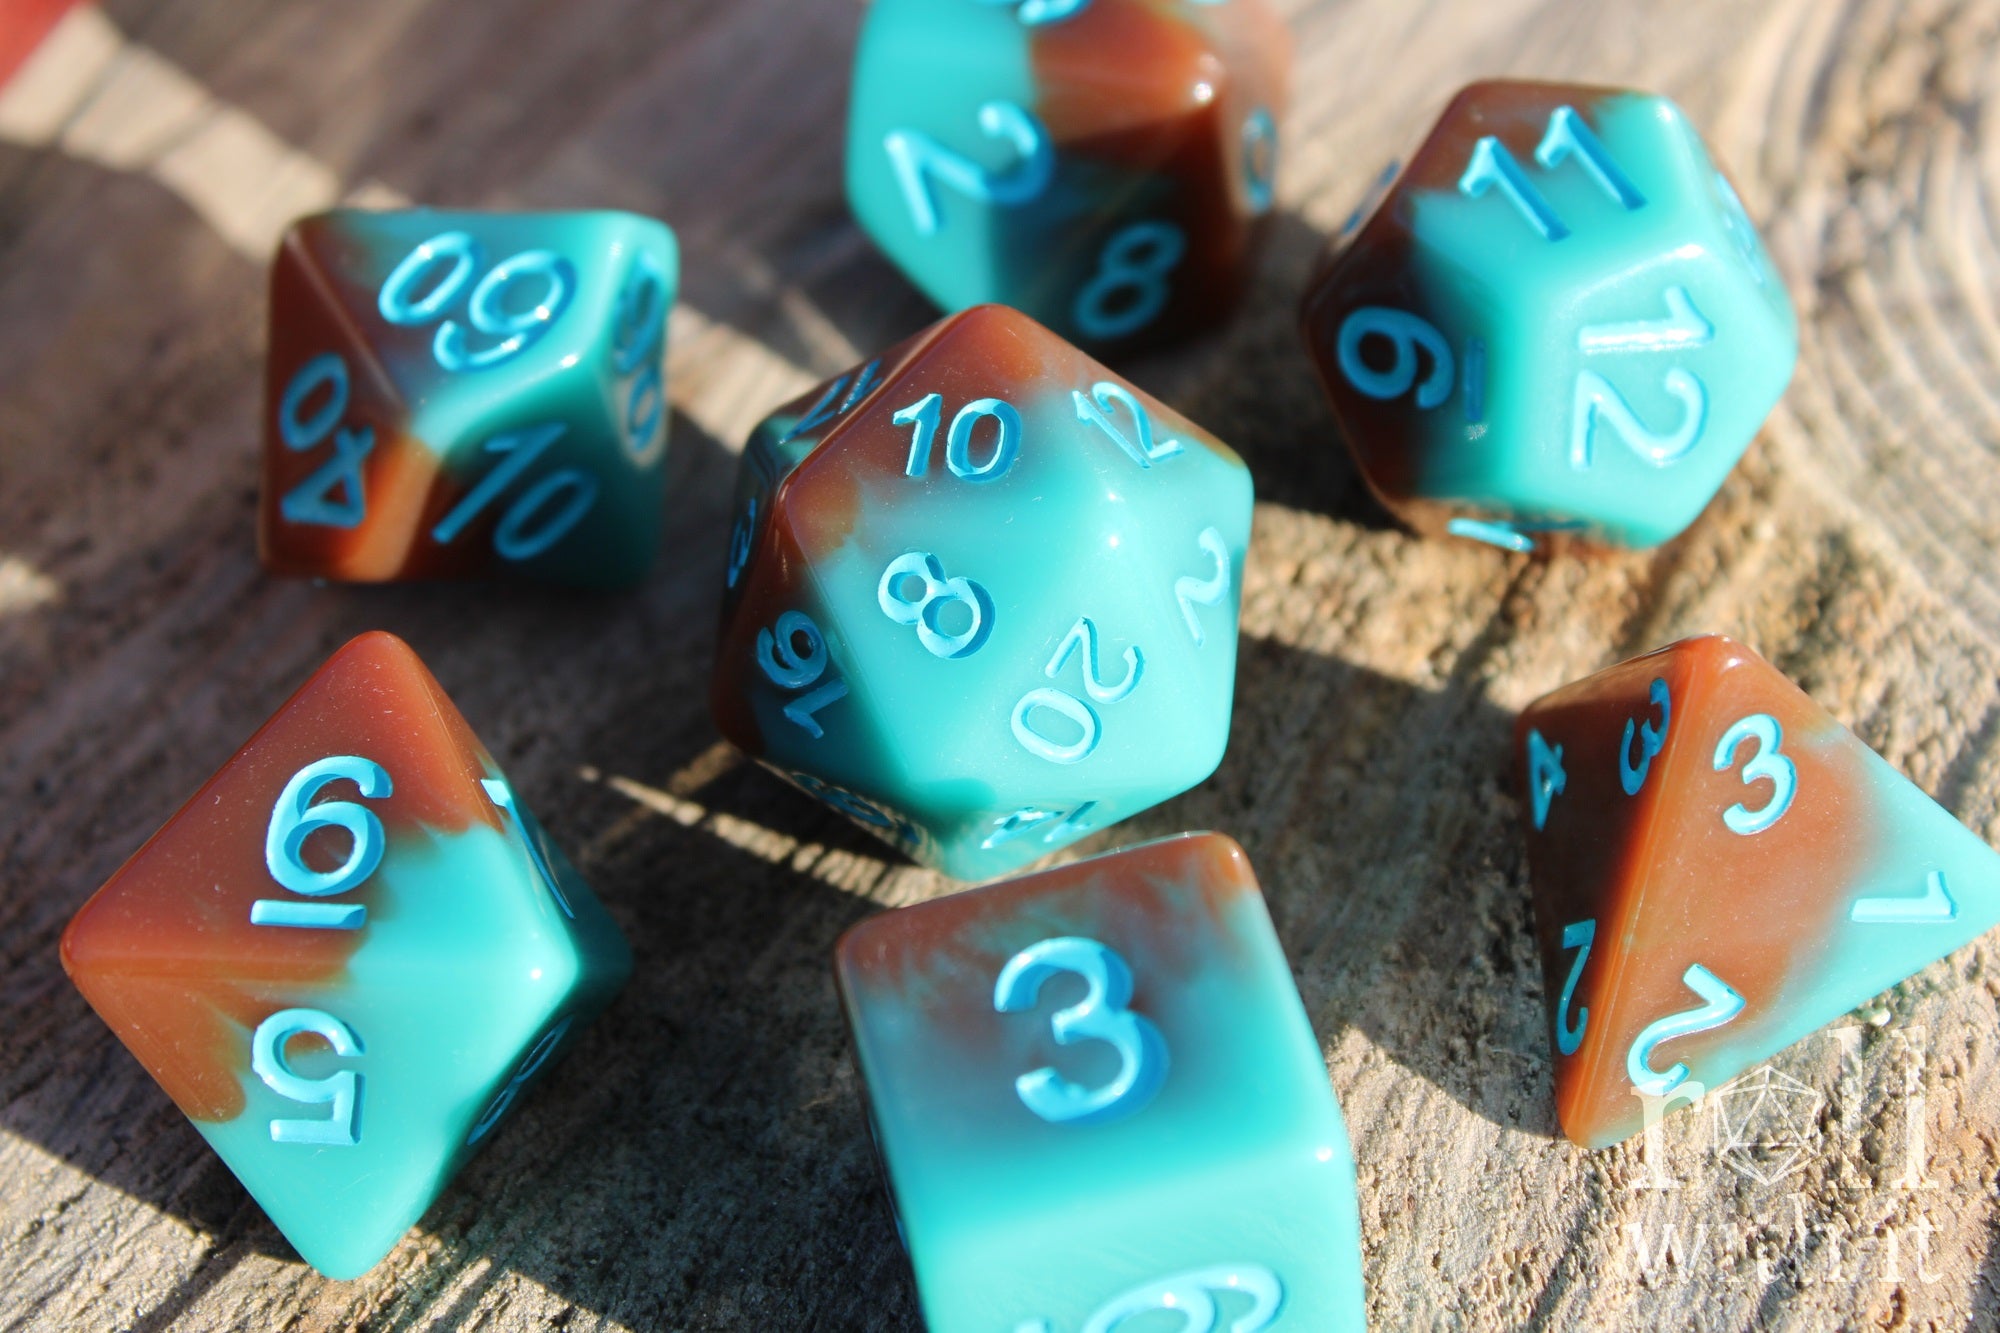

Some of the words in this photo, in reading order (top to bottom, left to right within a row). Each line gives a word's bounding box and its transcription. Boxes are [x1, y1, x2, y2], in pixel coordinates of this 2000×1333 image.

[1459, 105, 1648, 241] 11
[1073, 220, 1186, 339] 8
[279, 354, 376, 529] 40
[892, 393, 1022, 483] 10
[1072, 381, 1185, 468] 12
[1570, 285, 1715, 472] 12
[431, 423, 595, 560] 10
[878, 551, 996, 660] 8
[1174, 526, 1231, 647] 2
[756, 610, 849, 739] 16
[1011, 617, 1145, 764] 20
[1619, 677, 1671, 796] 3
[1527, 727, 1567, 832] 4
[1713, 713, 1797, 836] 3
[1850, 870, 1959, 923] 1
[993, 936, 1171, 1124] 3
[1556, 918, 1597, 1056] 2
[1626, 962, 1747, 1096] 2
[251, 1008, 366, 1145] 5
